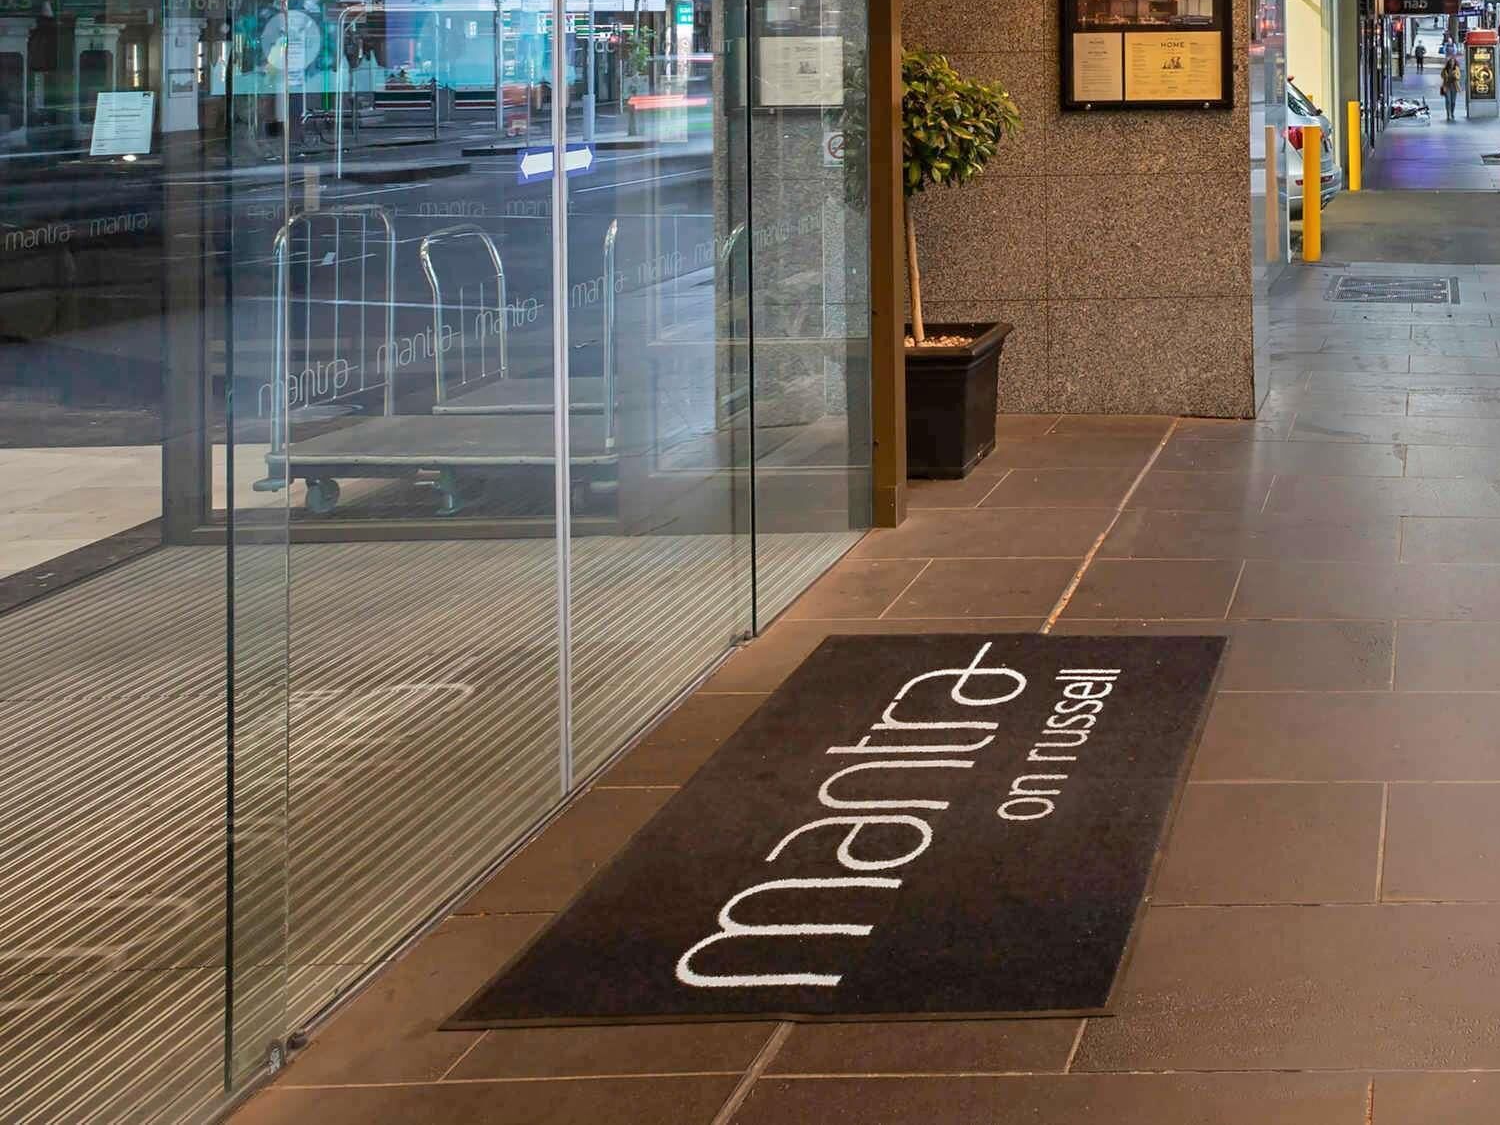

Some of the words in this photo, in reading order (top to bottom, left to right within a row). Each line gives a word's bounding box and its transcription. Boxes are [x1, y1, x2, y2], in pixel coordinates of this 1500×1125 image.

[4, 221, 76, 252] mantra
[88, 211, 152, 237] mantra
[376, 323, 463, 375] mantra
[1027, 667, 1122, 763] russell
[675, 641, 1028, 987] mantra
[998, 772, 1068, 822] on
